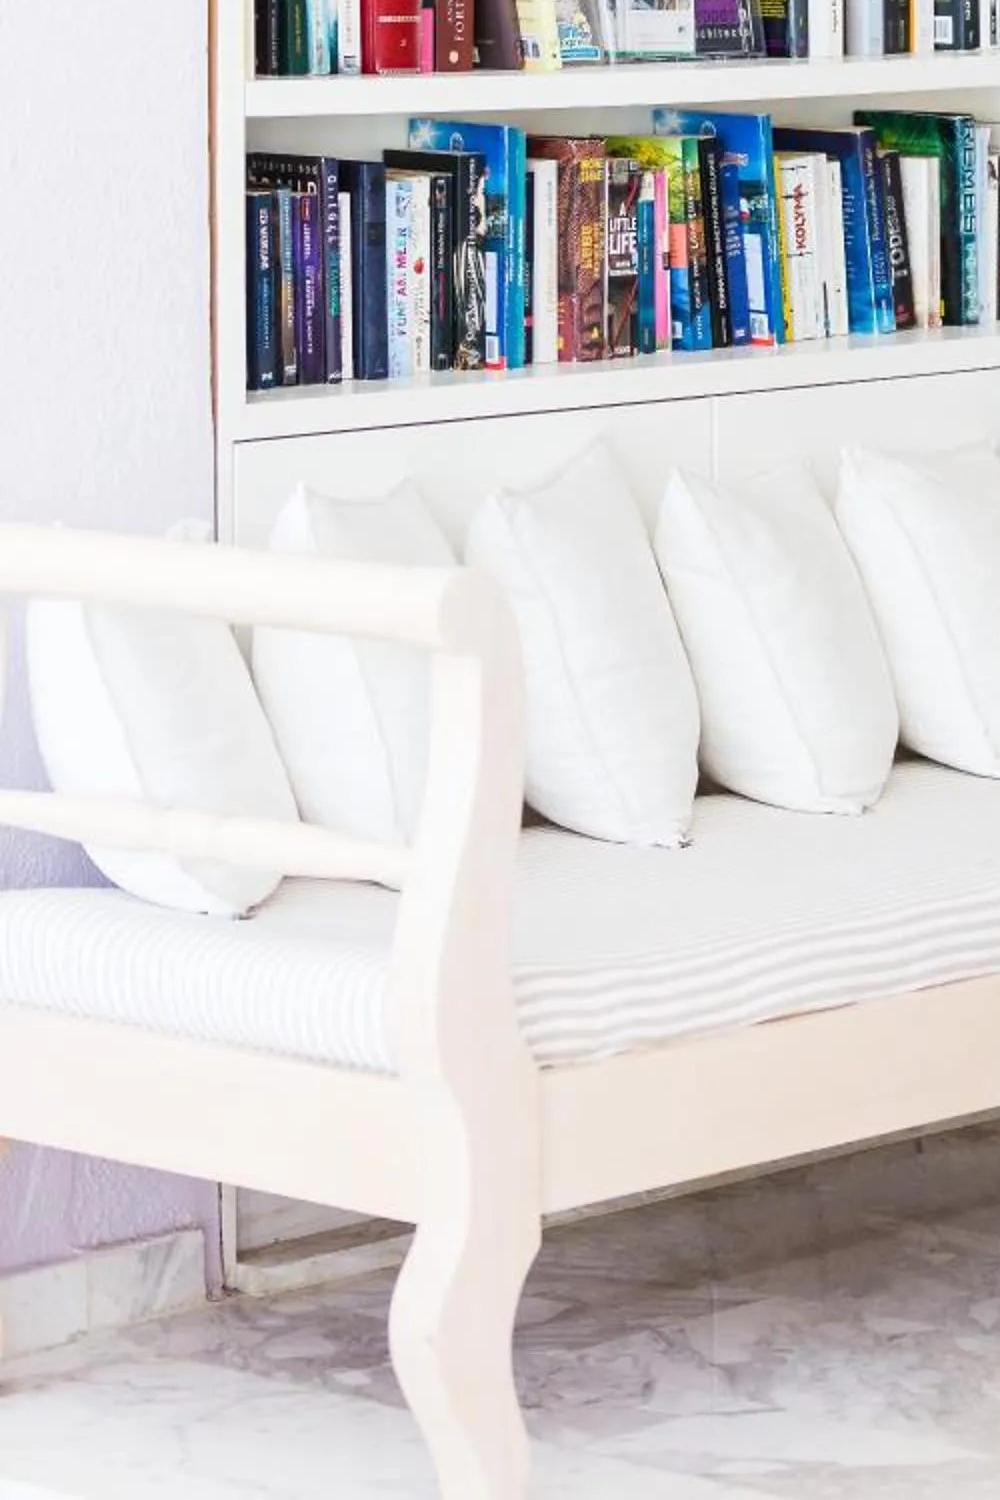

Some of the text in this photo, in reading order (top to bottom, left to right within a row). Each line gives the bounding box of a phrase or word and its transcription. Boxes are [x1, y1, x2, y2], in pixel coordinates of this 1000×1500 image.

[962, 121, 977, 234] REMES
[618, 201, 627, 217] A
[793, 183, 807, 250] KOLYMA
[609, 217, 637, 231] LITTLE
[609, 232, 637, 255] LIFE
